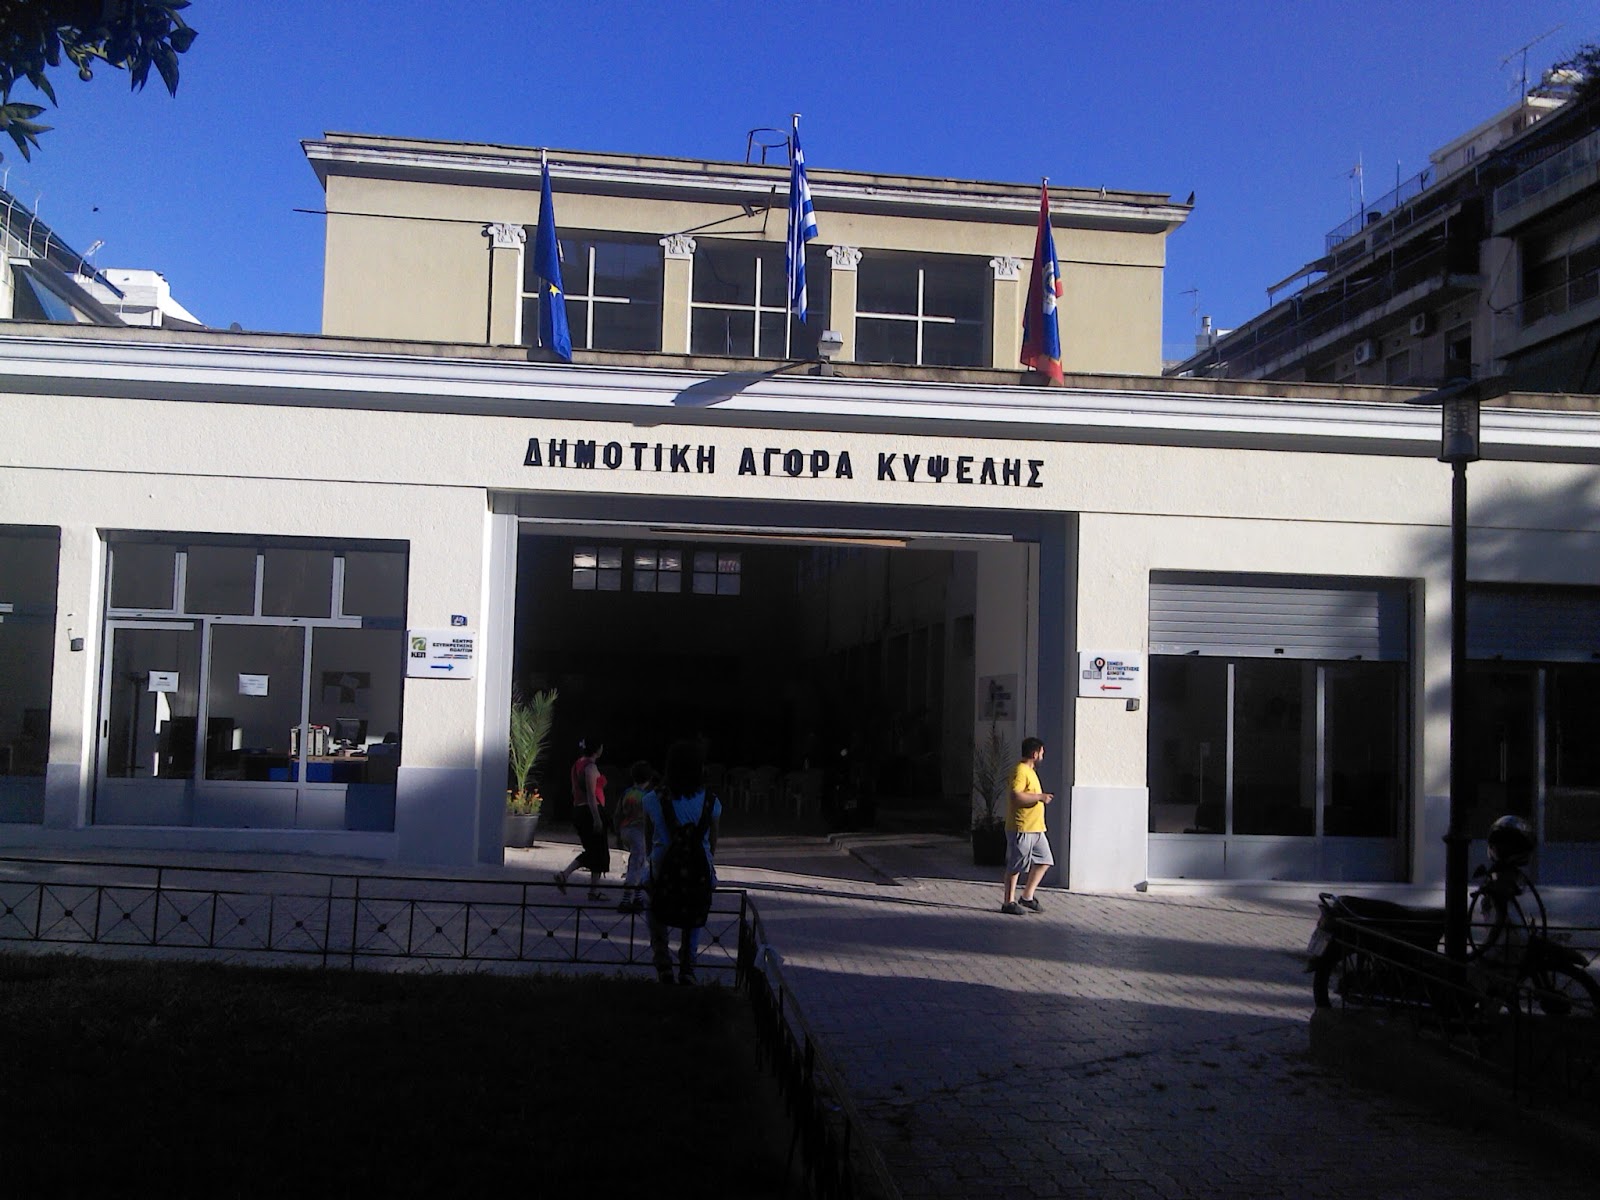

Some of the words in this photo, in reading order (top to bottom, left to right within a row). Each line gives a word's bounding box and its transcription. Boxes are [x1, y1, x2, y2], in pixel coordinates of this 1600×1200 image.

[523, 438, 715, 474] ΔΗΜΟΤΙΚΗ
[738, 447, 853, 479] ΑΓΟΡΑ
[877, 452, 1044, 487] ΚΥΨΕΛΗΣ
